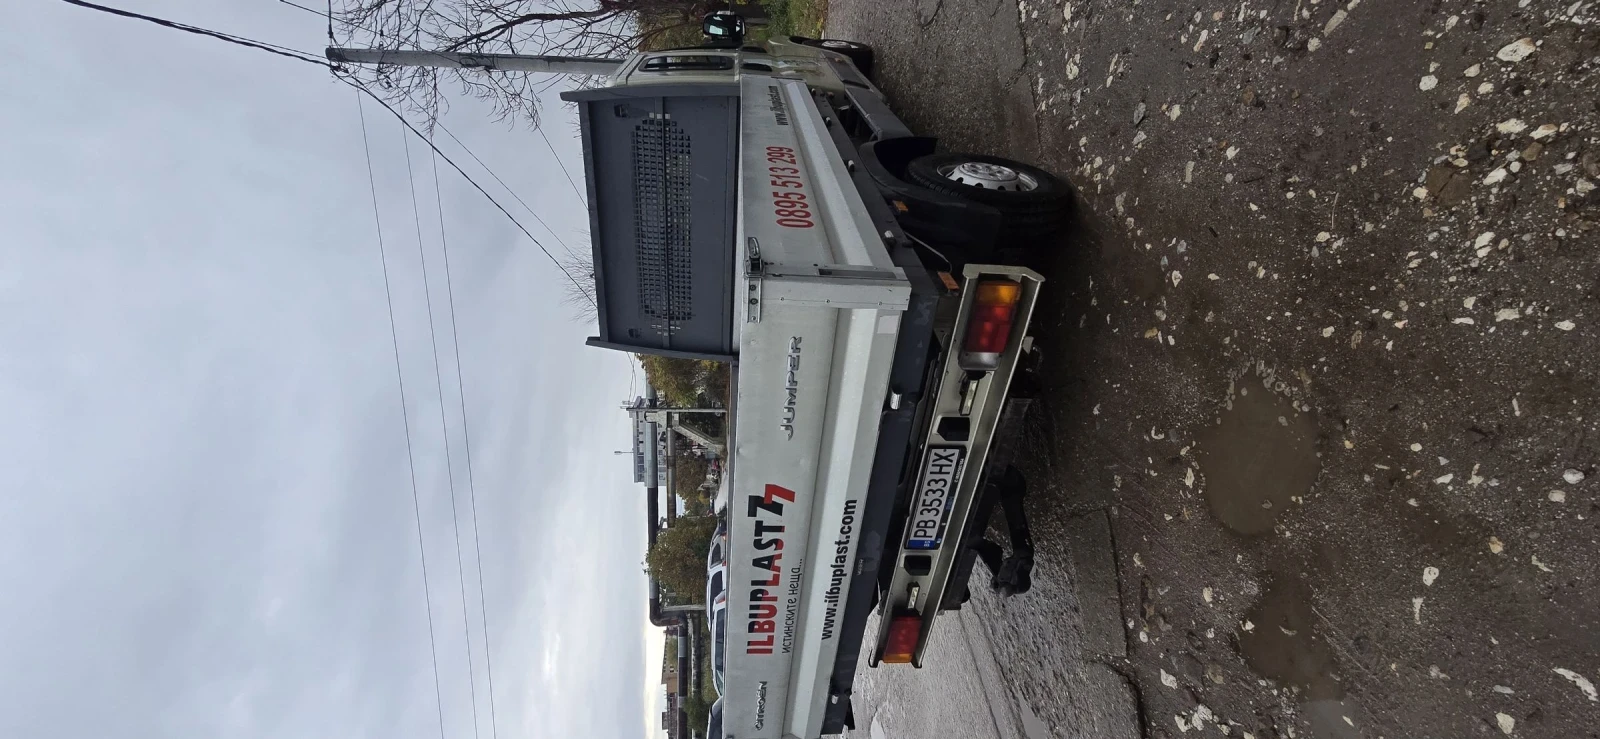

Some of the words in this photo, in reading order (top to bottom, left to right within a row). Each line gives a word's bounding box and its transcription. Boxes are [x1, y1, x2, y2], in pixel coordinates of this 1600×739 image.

[766, 146, 797, 165] 299
[768, 166, 803, 188] 513
[772, 192, 814, 228] 0895
[779, 336, 802, 441] JUMPER
[929, 452, 955, 475] HX
[919, 478, 948, 517] 3533
[913, 519, 937, 539] PB
[746, 520, 785, 654] ILBUPLAST
[821, 499, 857, 640] www.ilbuplast.com
